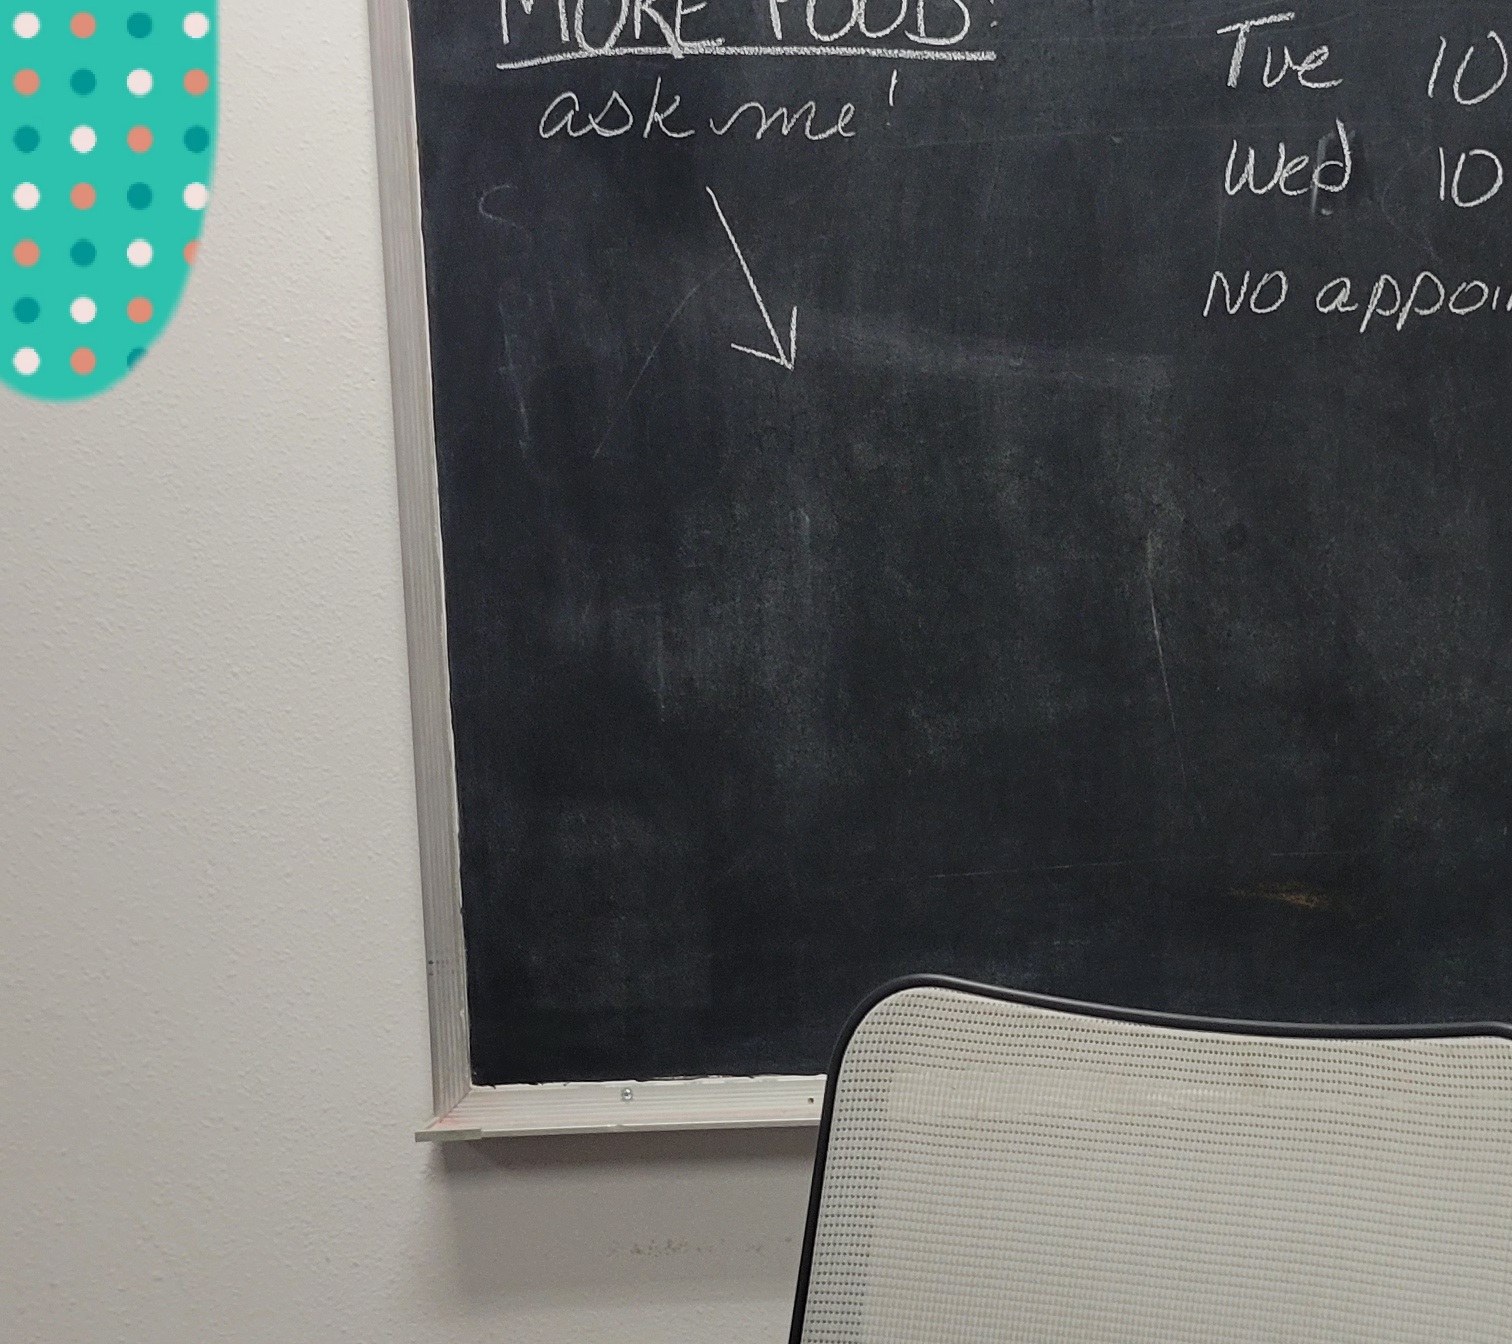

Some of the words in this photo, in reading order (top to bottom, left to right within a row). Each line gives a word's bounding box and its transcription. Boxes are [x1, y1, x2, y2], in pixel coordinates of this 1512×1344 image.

[1216, 11, 1343, 90] Tue
[538, 76, 696, 140] ask
[709, 68, 899, 141] me!
[1223, 118, 1353, 200] Wed
